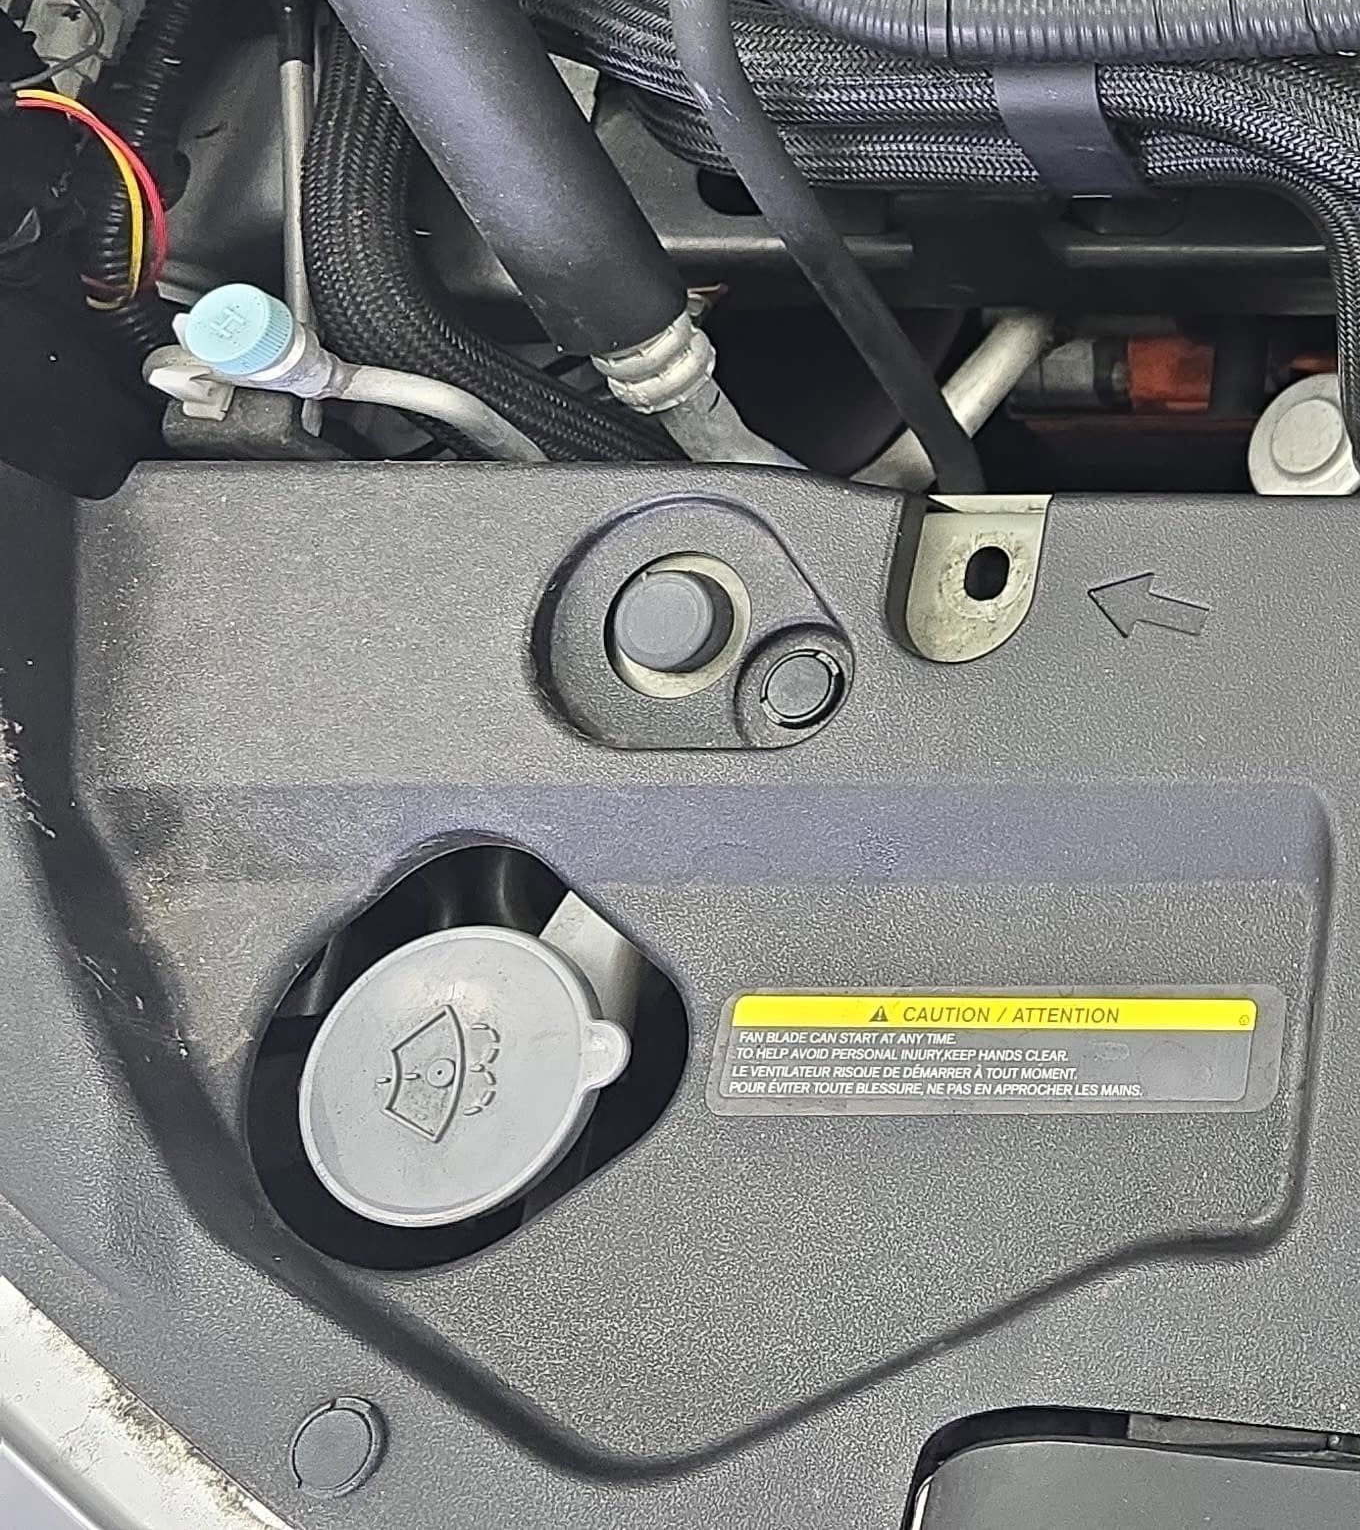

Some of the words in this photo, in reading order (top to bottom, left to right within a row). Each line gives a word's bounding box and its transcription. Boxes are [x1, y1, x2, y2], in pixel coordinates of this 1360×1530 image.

[903, 1007, 991, 1023] CAUTION
[998, 1007, 1008, 1023] /
[1012, 1008, 1120, 1024] ATTENTION
[739, 1032, 765, 1043] FAN
[766, 1032, 807, 1044] BLADE
[809, 1032, 837, 1044] CAN
[838, 1032, 881, 1044] START
[880, 1032, 894, 1044] AT
[898, 1033, 923, 1044] ANY
[927, 1033, 957, 1044] TIME.
[736, 1048, 754, 1059] TO
[756, 1048, 788, 1059] HELP
[790, 1048, 829, 1060] AVOID
[831, 1048, 898, 1060] PERSONAL
[978, 1050, 1028, 1062] HANDS
[1025, 1050, 1068, 1062] CLEAR.
[732, 1066, 747, 1077] LE
[751, 1066, 830, 1078] VENTILATEUR
[833, 1066, 881, 1078] RISQUE
[883, 1067, 900, 1078] DE
[903, 1064, 972, 1079] DÉMARRER
[974, 1064, 984, 1079] À
[986, 1068, 1018, 1080] TOUT
[729, 1082, 766, 1094] POUR
[768, 1078, 810, 1094] ÉVITER
[813, 1082, 854, 1094] TOUTE
[855, 1082, 924, 1096] BLESSURE,
[927, 1083, 945, 1094] NE
[946, 1083, 973, 1095] PAS
[974, 1084, 993, 1095] EN
[994, 1084, 1073, 1096] APPROCHER
[1074, 1084, 1098, 1096] LES
[1100, 1085, 1143, 1096] MAINS.
